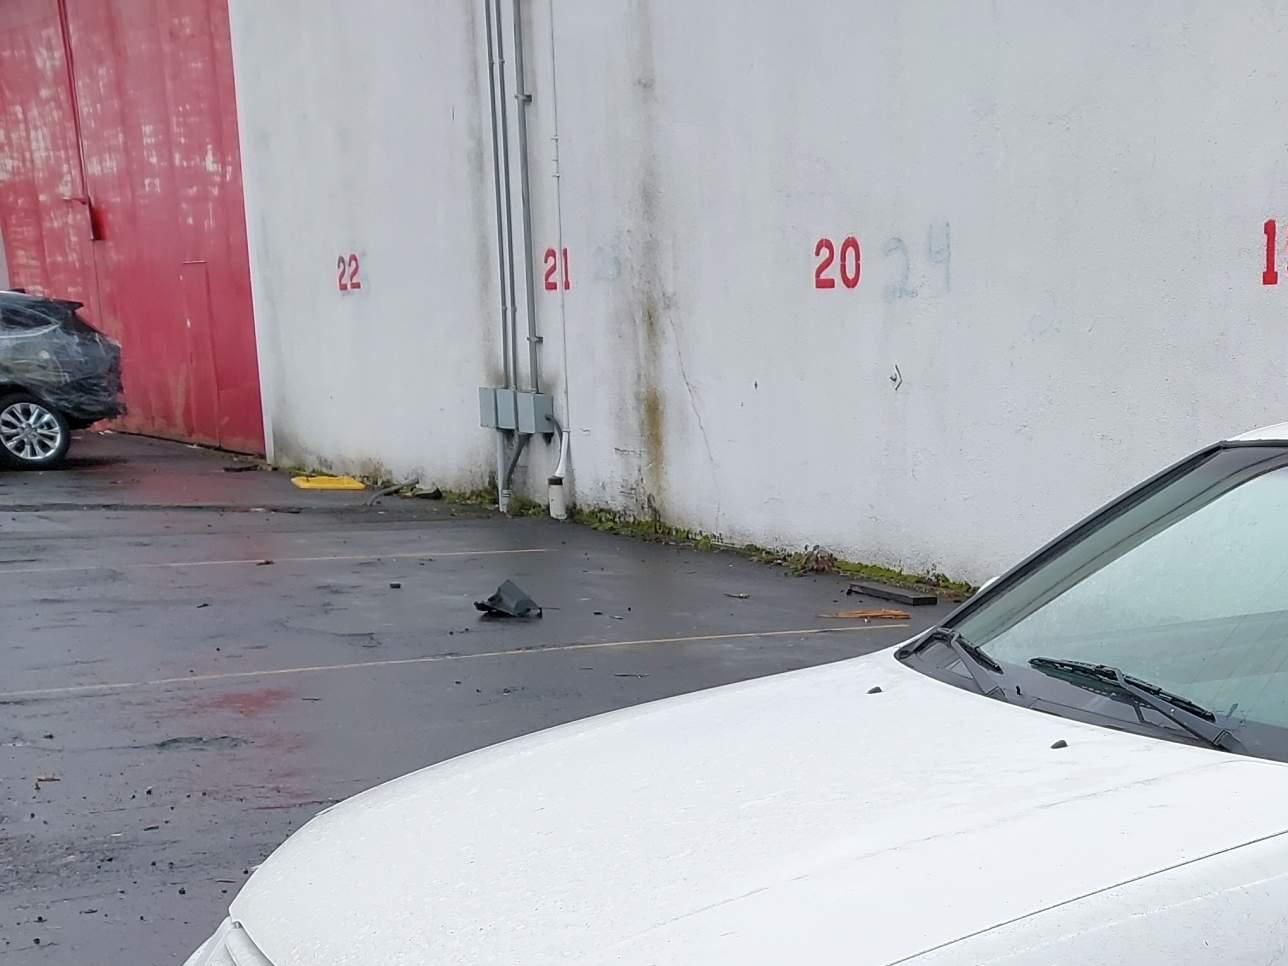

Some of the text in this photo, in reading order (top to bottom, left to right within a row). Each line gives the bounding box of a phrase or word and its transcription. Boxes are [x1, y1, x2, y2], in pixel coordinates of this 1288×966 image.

[337, 253, 361, 291] 22
[543, 247, 570, 291] 21
[814, 236, 861, 289] 20
